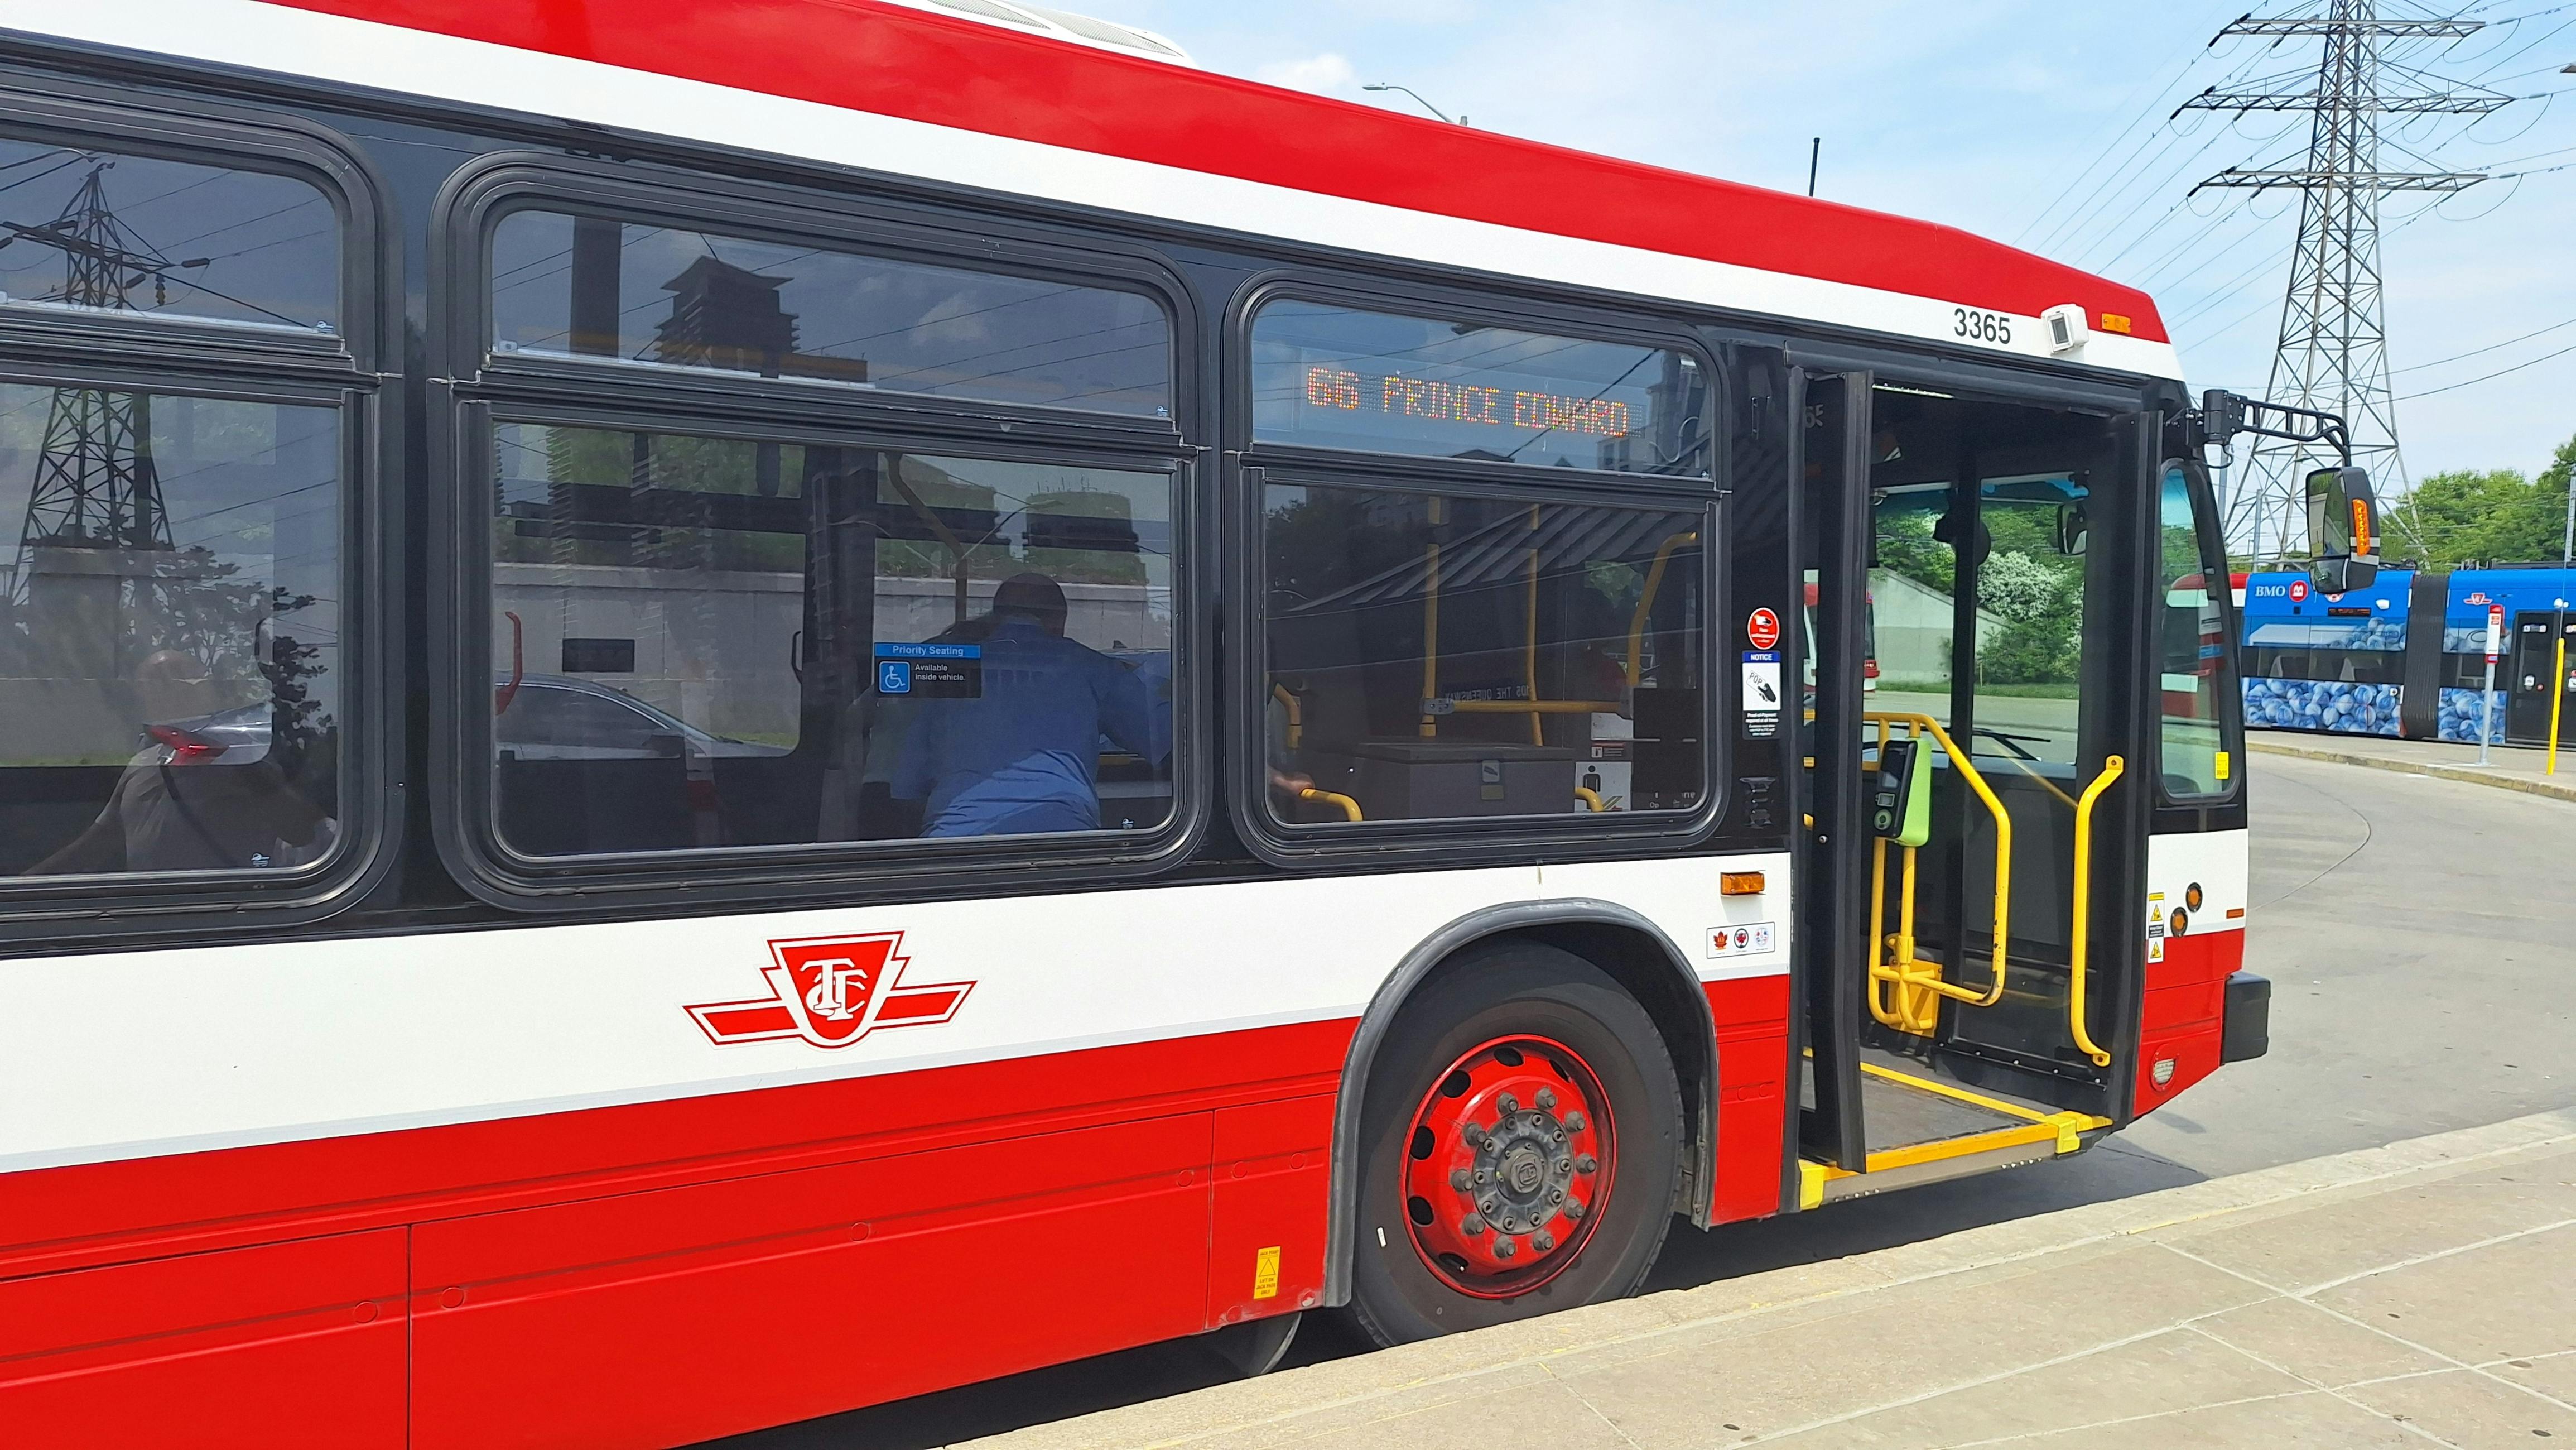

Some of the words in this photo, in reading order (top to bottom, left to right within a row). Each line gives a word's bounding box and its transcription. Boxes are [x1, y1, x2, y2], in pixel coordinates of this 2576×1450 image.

[1953, 308, 2011, 345] 3365
[1307, 366, 1359, 410] 66
[1384, 374, 1500, 424] PRINCE
[1514, 390, 1628, 438] EDWARD
[2255, 585, 2286, 597] BMO
[893, 645, 927, 656] Priority
[929, 646, 964, 657] Seating
[915, 664, 948, 672] Available
[1749, 672, 1763, 685] POP
